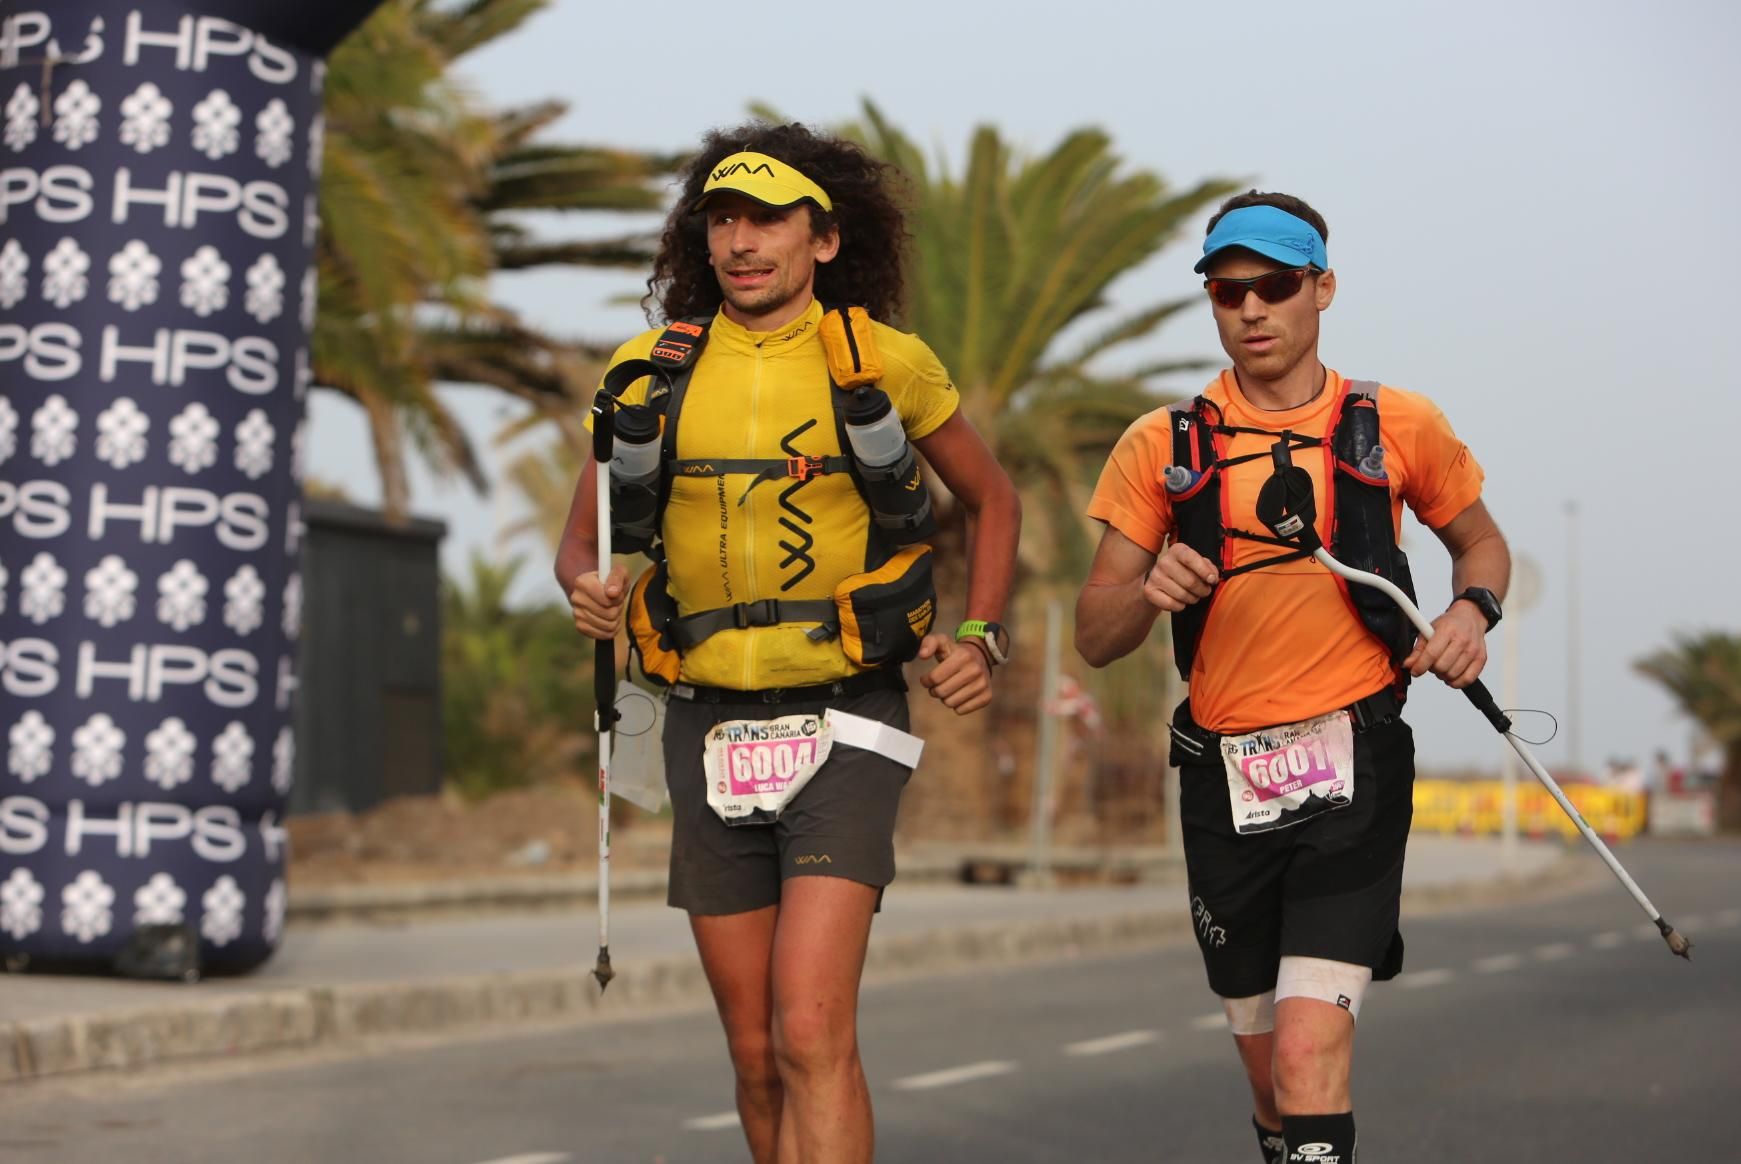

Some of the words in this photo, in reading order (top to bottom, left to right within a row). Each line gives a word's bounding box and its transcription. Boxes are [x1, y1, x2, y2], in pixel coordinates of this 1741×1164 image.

[123, 9, 297, 84] HPS
[0, 164, 94, 224] PS
[111, 166, 289, 239] HPS
[0, 321, 82, 381] PS
[99, 324, 279, 395] HPS
[87, 482, 269, 551] HPS
[717, 473, 729, 530] EQUIPMEN
[719, 533, 729, 568] ULTRA
[76, 640, 259, 708] HPS
[769, 723, 790, 732] GRAN
[770, 730, 801, 740] CANARIA
[1249, 739, 1328, 789] 6001
[1279, 779, 1303, 795] PETER
[64, 798, 247, 863] HPS
